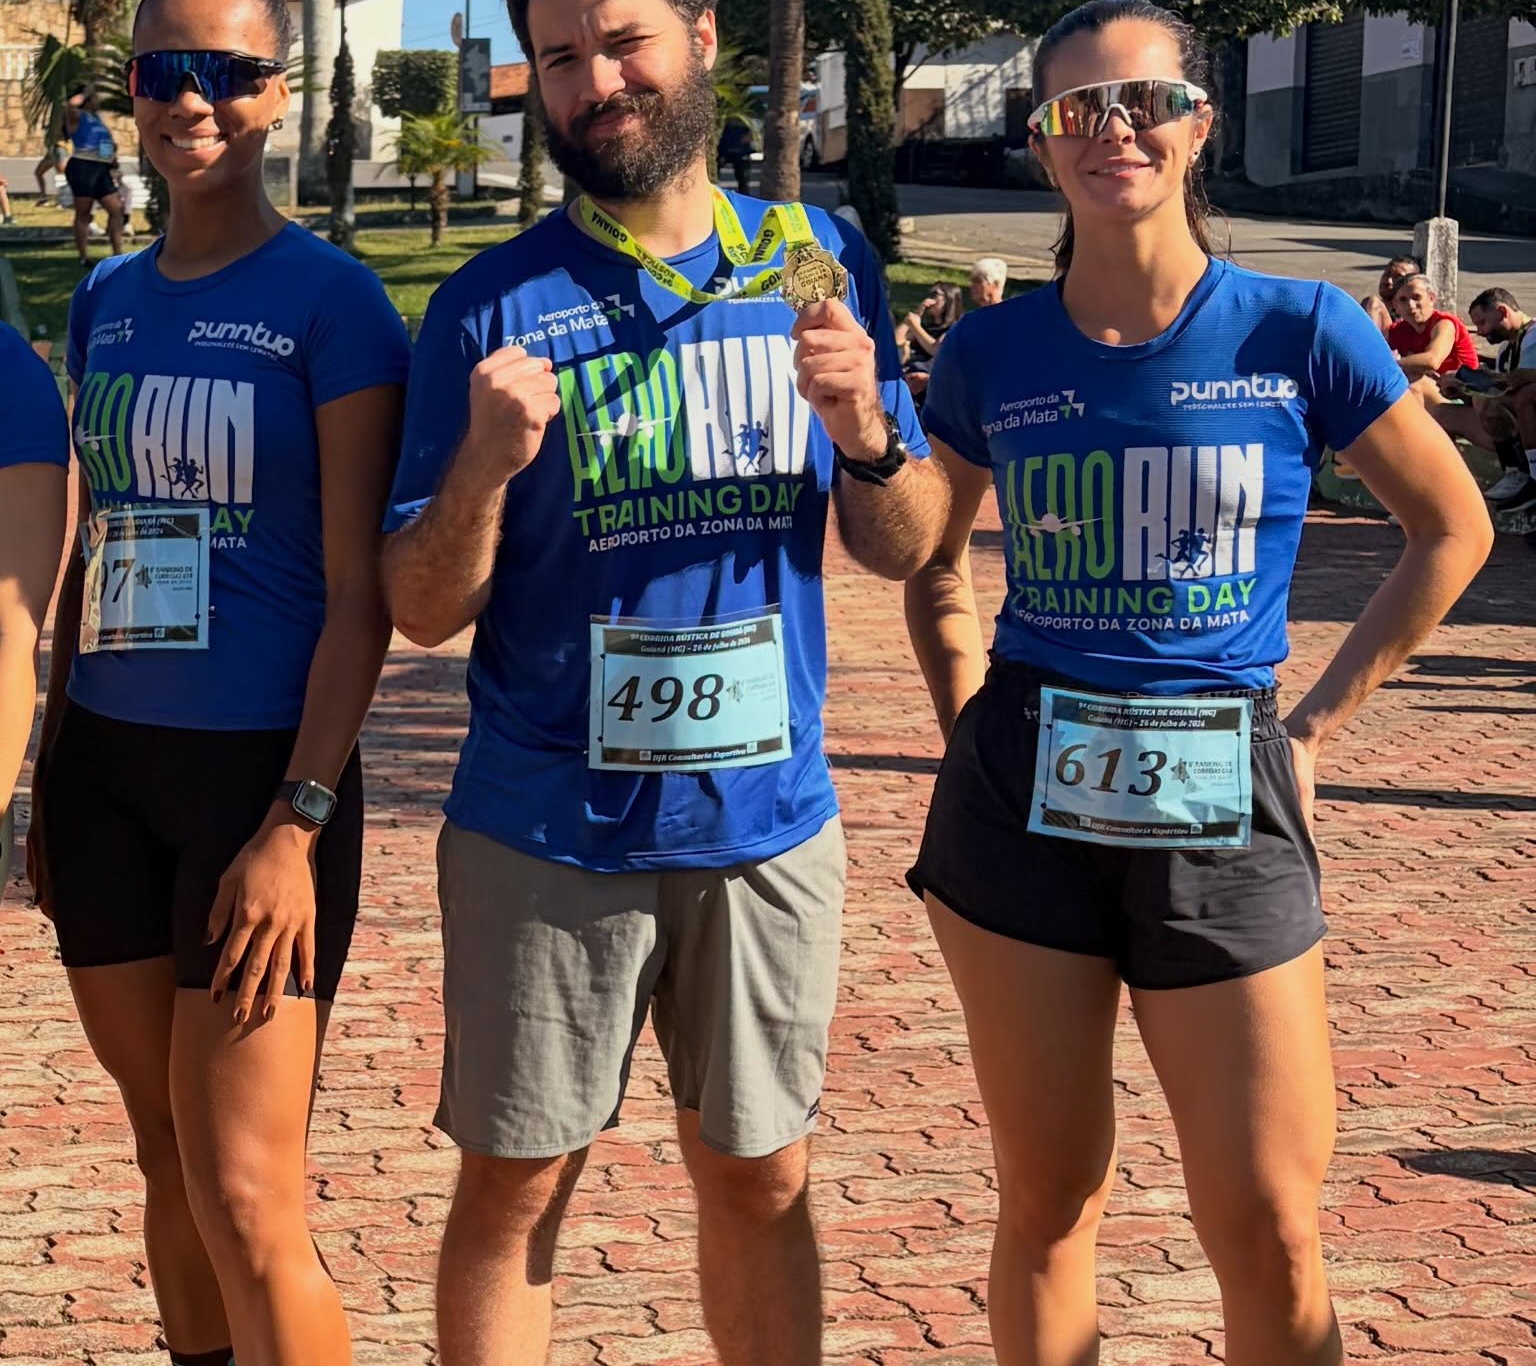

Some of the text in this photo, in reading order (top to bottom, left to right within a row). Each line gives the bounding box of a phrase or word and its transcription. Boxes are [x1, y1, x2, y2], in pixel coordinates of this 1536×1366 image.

[538, 304, 590, 323] Aeroporto
[187, 321, 295, 357] punntuo
[504, 314, 609, 347] Zona da Mata
[1000, 393, 1059, 412] Aeroporto da
[1171, 373, 1299, 405] punntuo
[558, 334, 810, 502] AERO RUN
[1004, 414, 1020, 429] da
[1023, 410, 1058, 425] Mata
[132, 375, 255, 504] RUN
[210, 507, 255, 534] AY
[573, 483, 804, 536] TRAINING DAY
[1007, 443, 1263, 581] AERO RUN
[589, 525, 670, 552] AEROPORTO
[675, 522, 696, 536] DA
[701, 517, 744, 535] ZONA
[747, 517, 763, 531] DA
[1188, 577, 1257, 614] DAY
[640, 634, 674, 642] CORRIDA
[676, 632, 708, 642] RÚSTICA
[710, 631, 720, 639] DE
[1099, 617, 1120, 630] DA
[1126, 616, 1174, 631] ZONA
[1180, 616, 1202, 630] DA
[1207, 610, 1249, 628] MATA
[667, 645, 685, 654] (MG)
[693, 643, 702, 651] 26
[703, 642, 712, 650] de
[712, 641, 729, 652] julho
[607, 674, 724, 722] 498
[1087, 704, 1121, 714] CORRIDA
[1124, 706, 1155, 716] RÚSTICA
[1158, 708, 1167, 716] DE
[1139, 719, 1148, 727] 26
[1150, 719, 1158, 727] de
[1159, 719, 1177, 729] julho
[1179, 719, 1187, 727] de
[1055, 743, 1167, 796] 613
